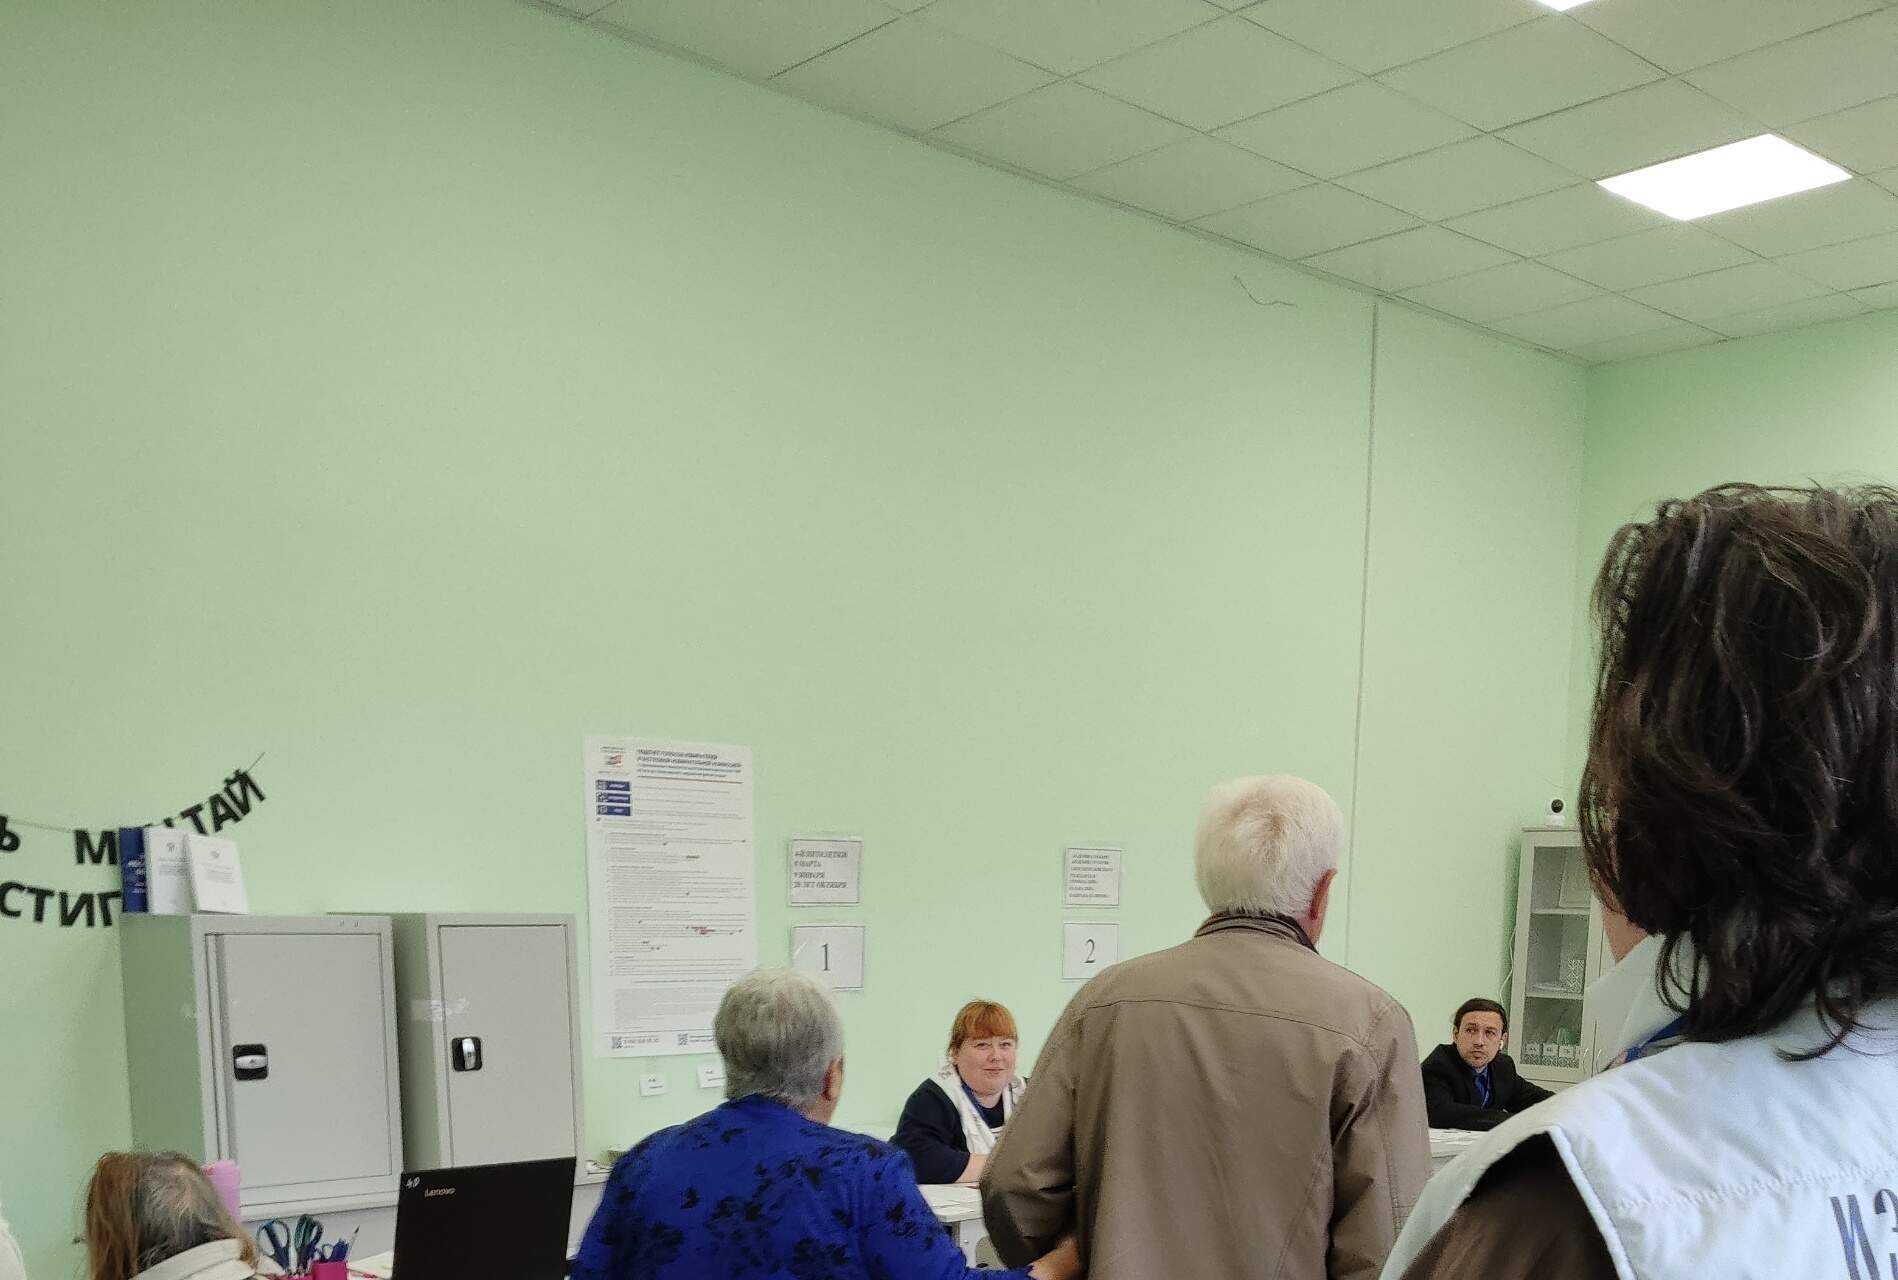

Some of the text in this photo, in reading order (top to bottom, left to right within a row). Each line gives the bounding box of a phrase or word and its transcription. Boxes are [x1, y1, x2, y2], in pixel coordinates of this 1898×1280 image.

[74, 768, 267, 866] МТАЙ
[821, 943, 831, 971] 1
[1084, 938, 1096, 964] 2
[424, 1187, 456, 1198] Lenovo
